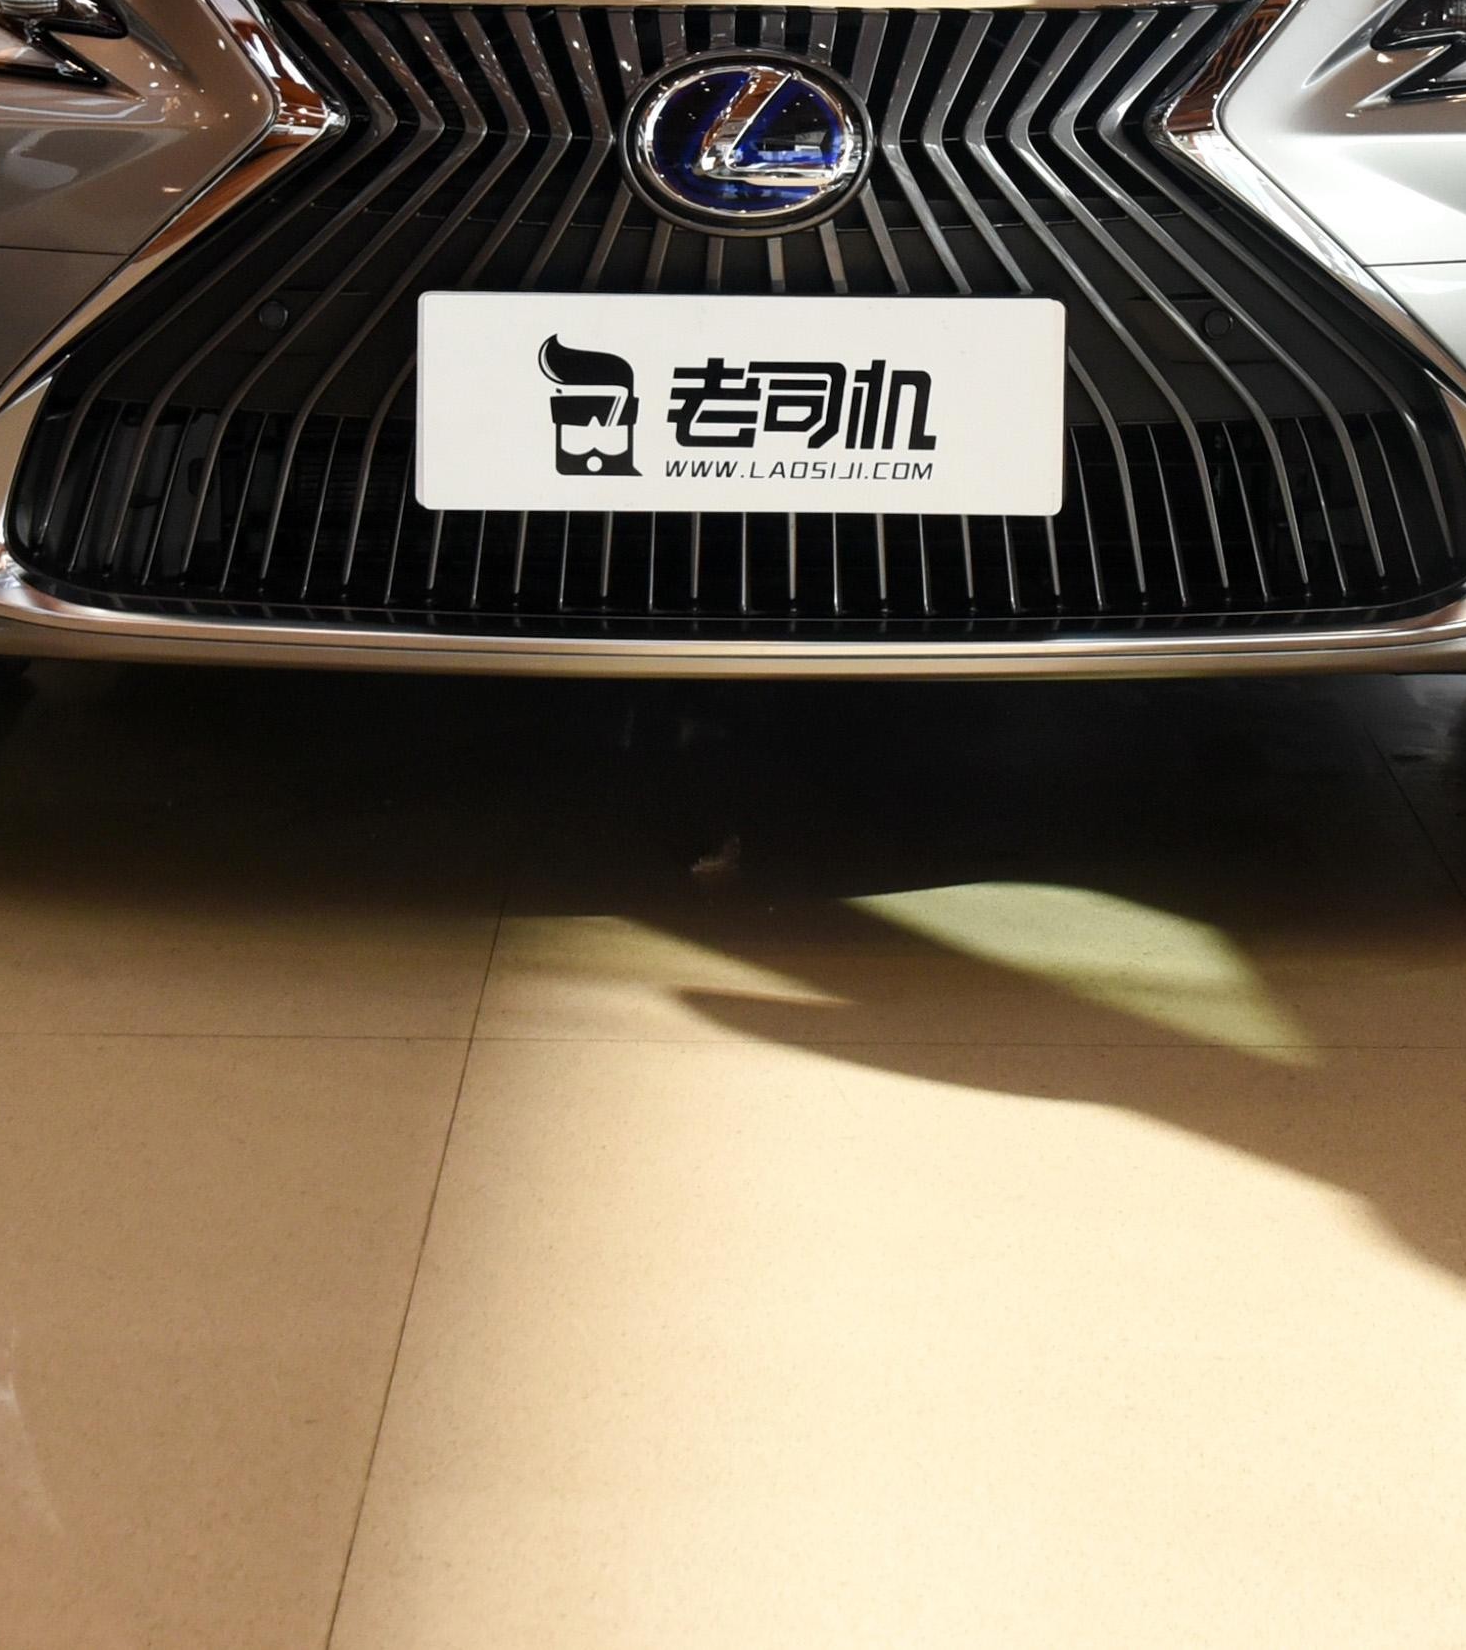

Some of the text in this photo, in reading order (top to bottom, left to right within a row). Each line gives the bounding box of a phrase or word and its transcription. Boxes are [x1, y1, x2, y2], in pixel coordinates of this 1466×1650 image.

[666, 357, 937, 450] 老司机
[665, 459, 934, 482] WWW.LAOSIJI.COM
